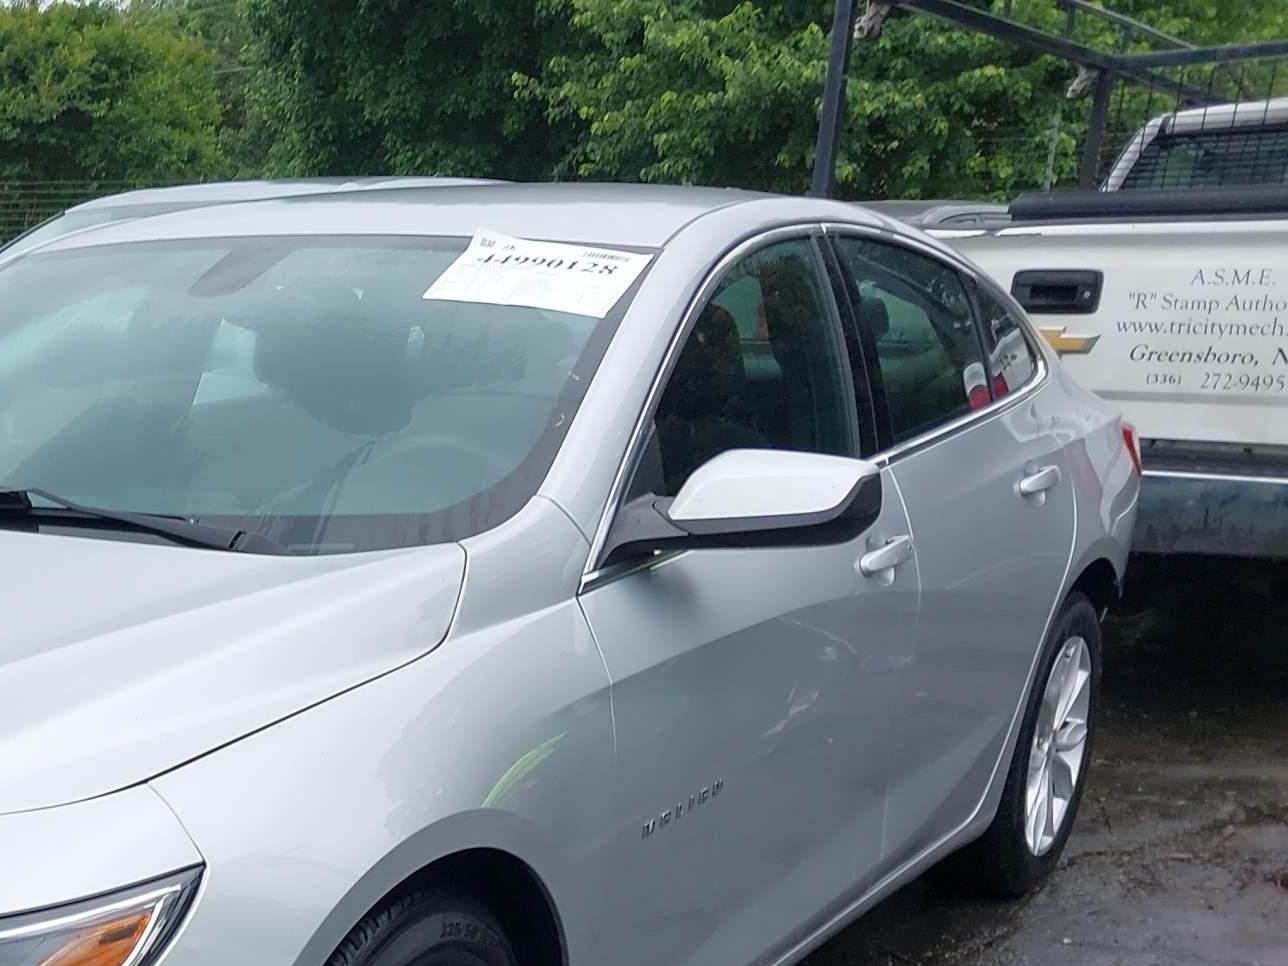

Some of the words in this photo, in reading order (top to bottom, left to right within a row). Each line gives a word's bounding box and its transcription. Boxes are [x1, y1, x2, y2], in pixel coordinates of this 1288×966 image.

[476, 253, 619, 276] 44990128
[1190, 268, 1277, 286] A.S.M.E.
[1129, 292, 1157, 311] "R"
[1161, 292, 1220, 315] Stamp
[1129, 343, 1260, 367] Greensboro,
[1146, 373, 1182, 386] (336)
[1200, 372, 1286, 393] 272-9495
